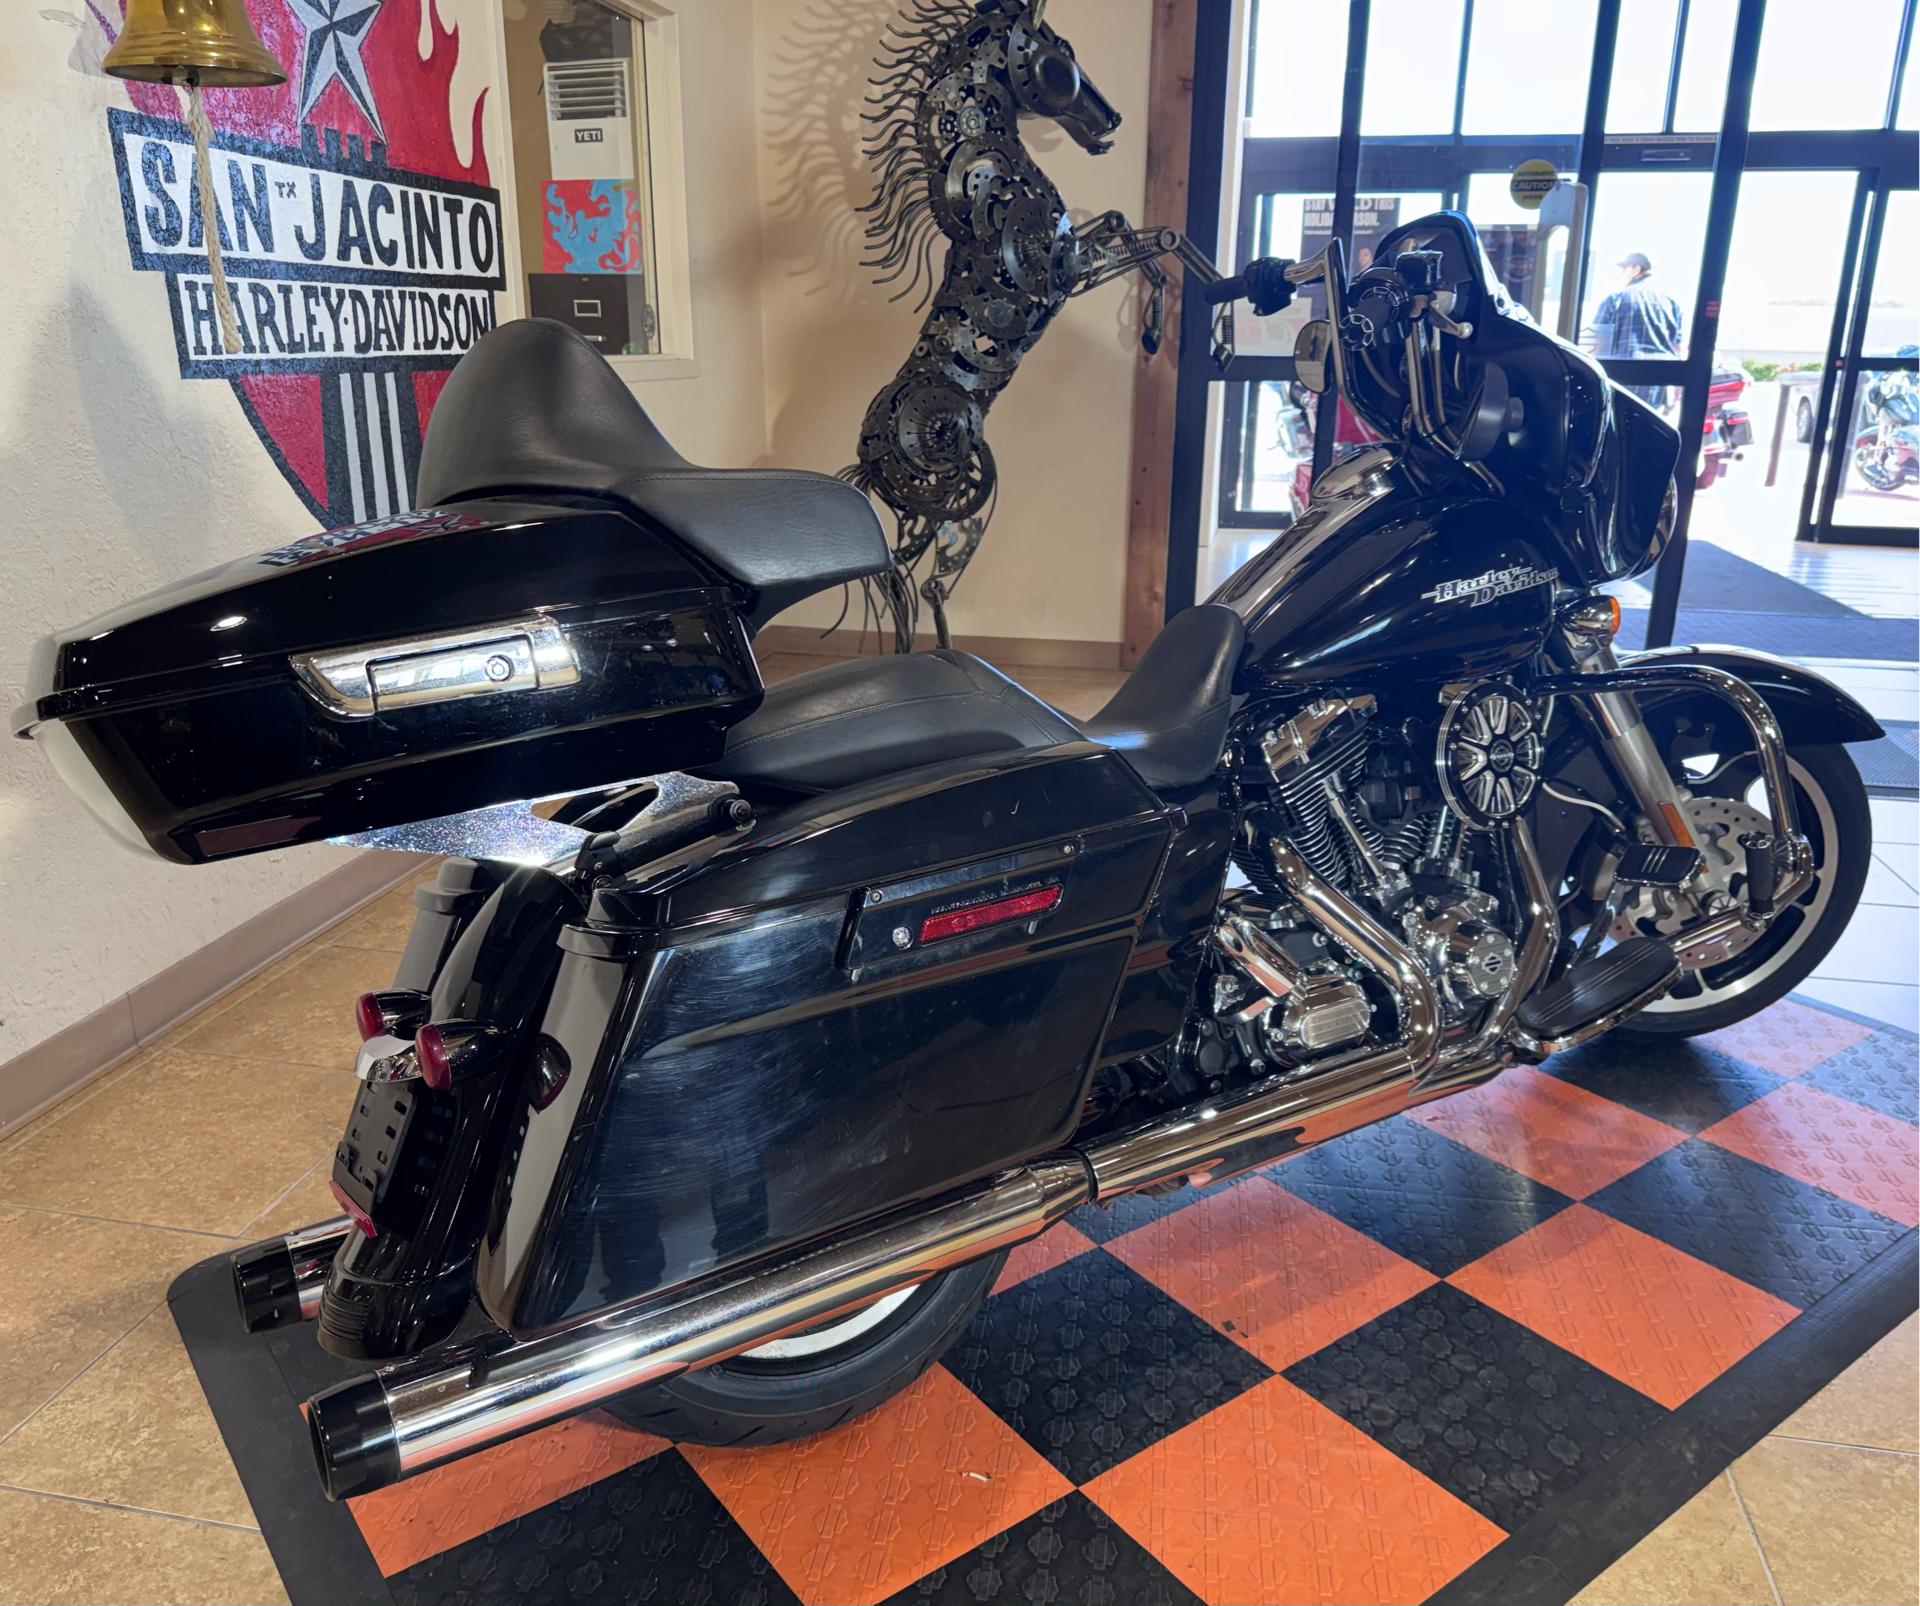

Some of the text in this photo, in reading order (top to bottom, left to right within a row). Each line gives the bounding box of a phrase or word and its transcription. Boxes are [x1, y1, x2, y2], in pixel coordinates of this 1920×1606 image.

[575, 130, 602, 141] YETI
[141, 142, 495, 274] SAN TX JACINTO
[1426, 566, 1530, 603] Harley
[1469, 567, 1559, 608] Davidson
